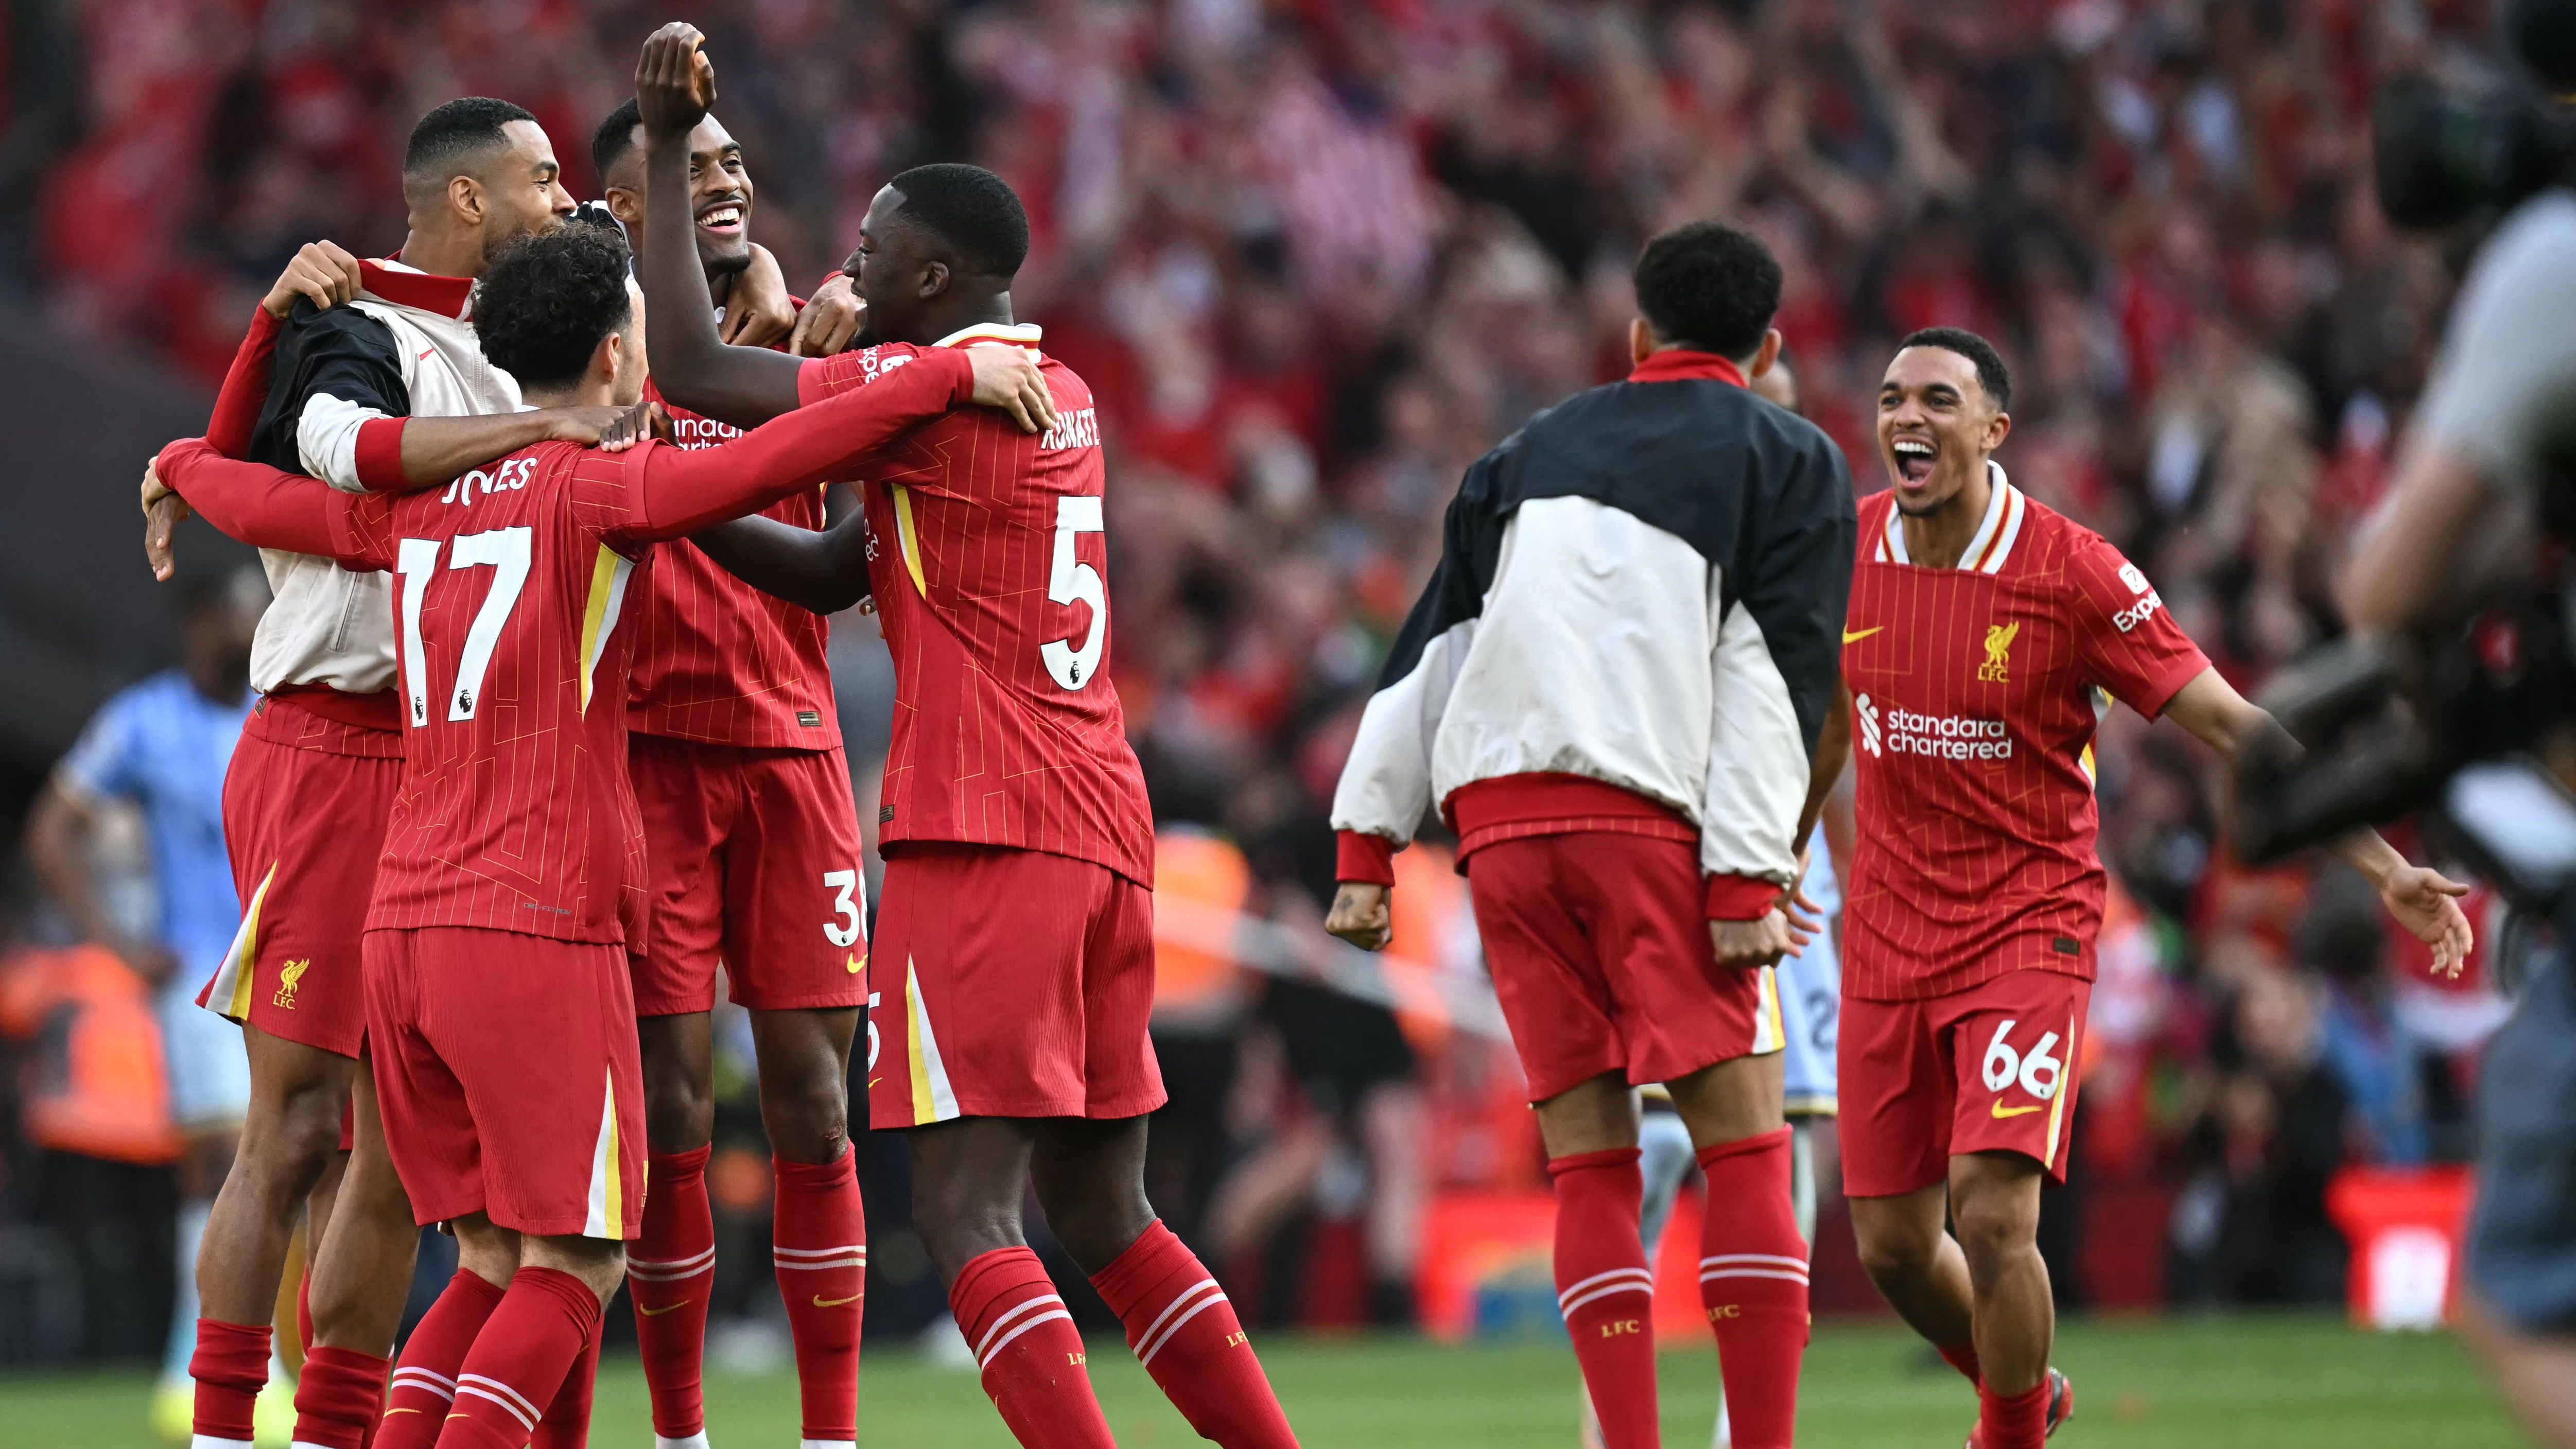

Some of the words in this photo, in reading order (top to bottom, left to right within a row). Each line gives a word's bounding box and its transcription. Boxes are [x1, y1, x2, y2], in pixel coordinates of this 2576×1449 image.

[396, 526, 532, 728] 17
[1040, 495, 1107, 691] 5
[1887, 731, 2012, 760] chartered
[1982, 1019, 2061, 1101] 66
[1602, 1319, 1641, 1338] LFC
